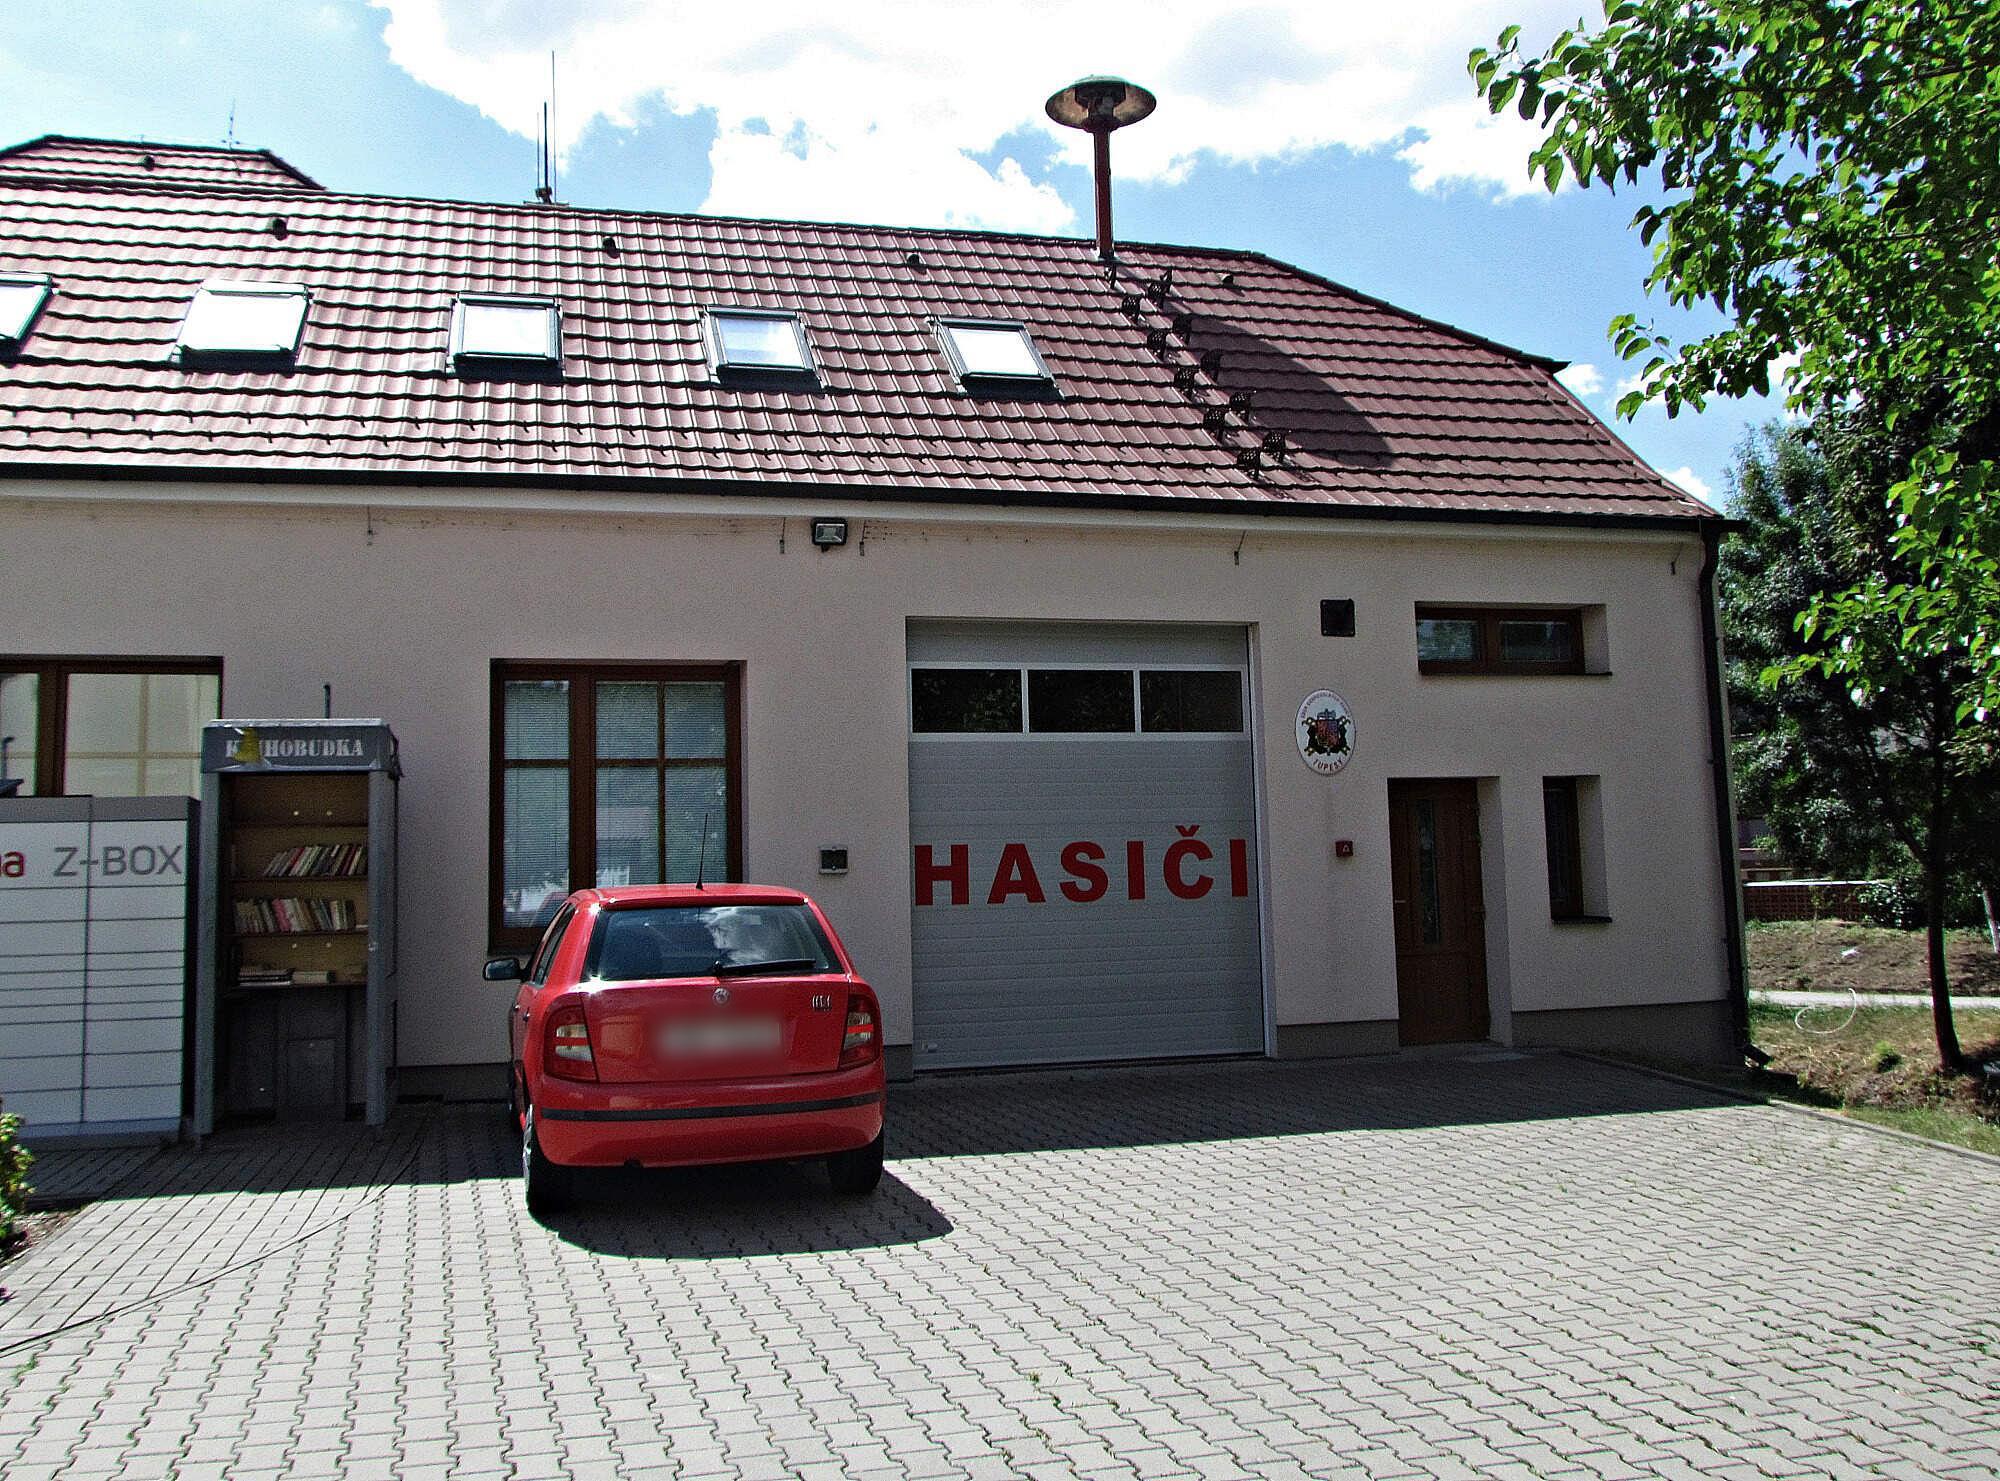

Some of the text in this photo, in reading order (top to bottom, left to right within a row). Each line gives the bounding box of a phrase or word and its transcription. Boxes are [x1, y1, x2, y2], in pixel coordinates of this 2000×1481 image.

[224, 738, 364, 757] KIHOBUDKA
[0, 844, 183, 878] a Z-BOX
[913, 825, 1249, 906] HASIČI
